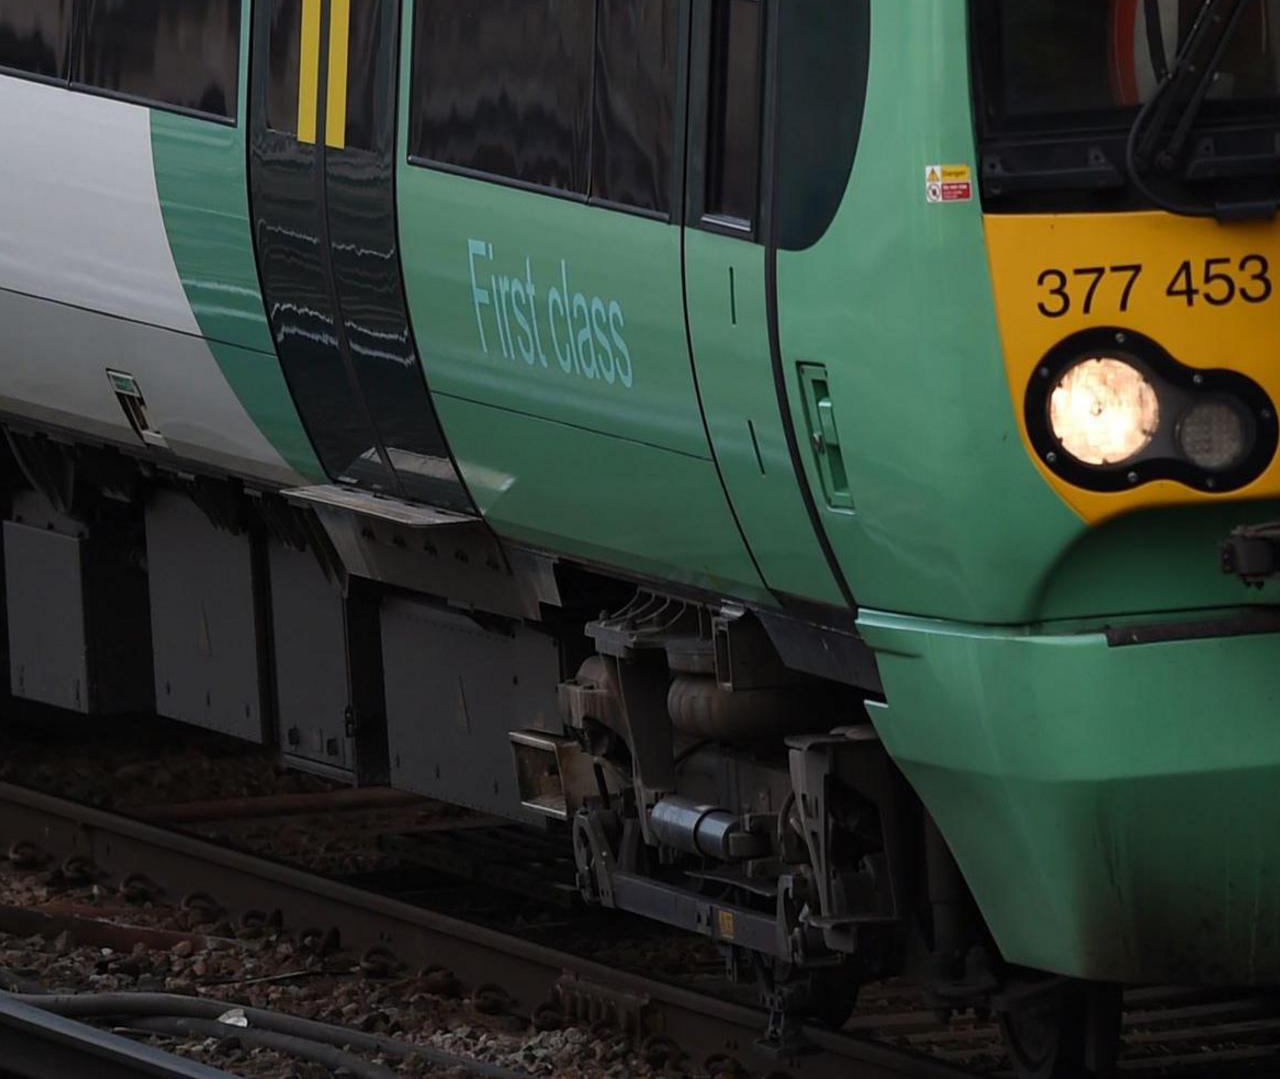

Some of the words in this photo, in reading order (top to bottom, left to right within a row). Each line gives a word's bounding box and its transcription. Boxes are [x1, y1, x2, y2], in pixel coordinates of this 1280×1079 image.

[468, 237, 548, 368] First
[548, 258, 632, 388] class
[1037, 264, 1142, 318] 377
[1166, 254, 1272, 307] 453
